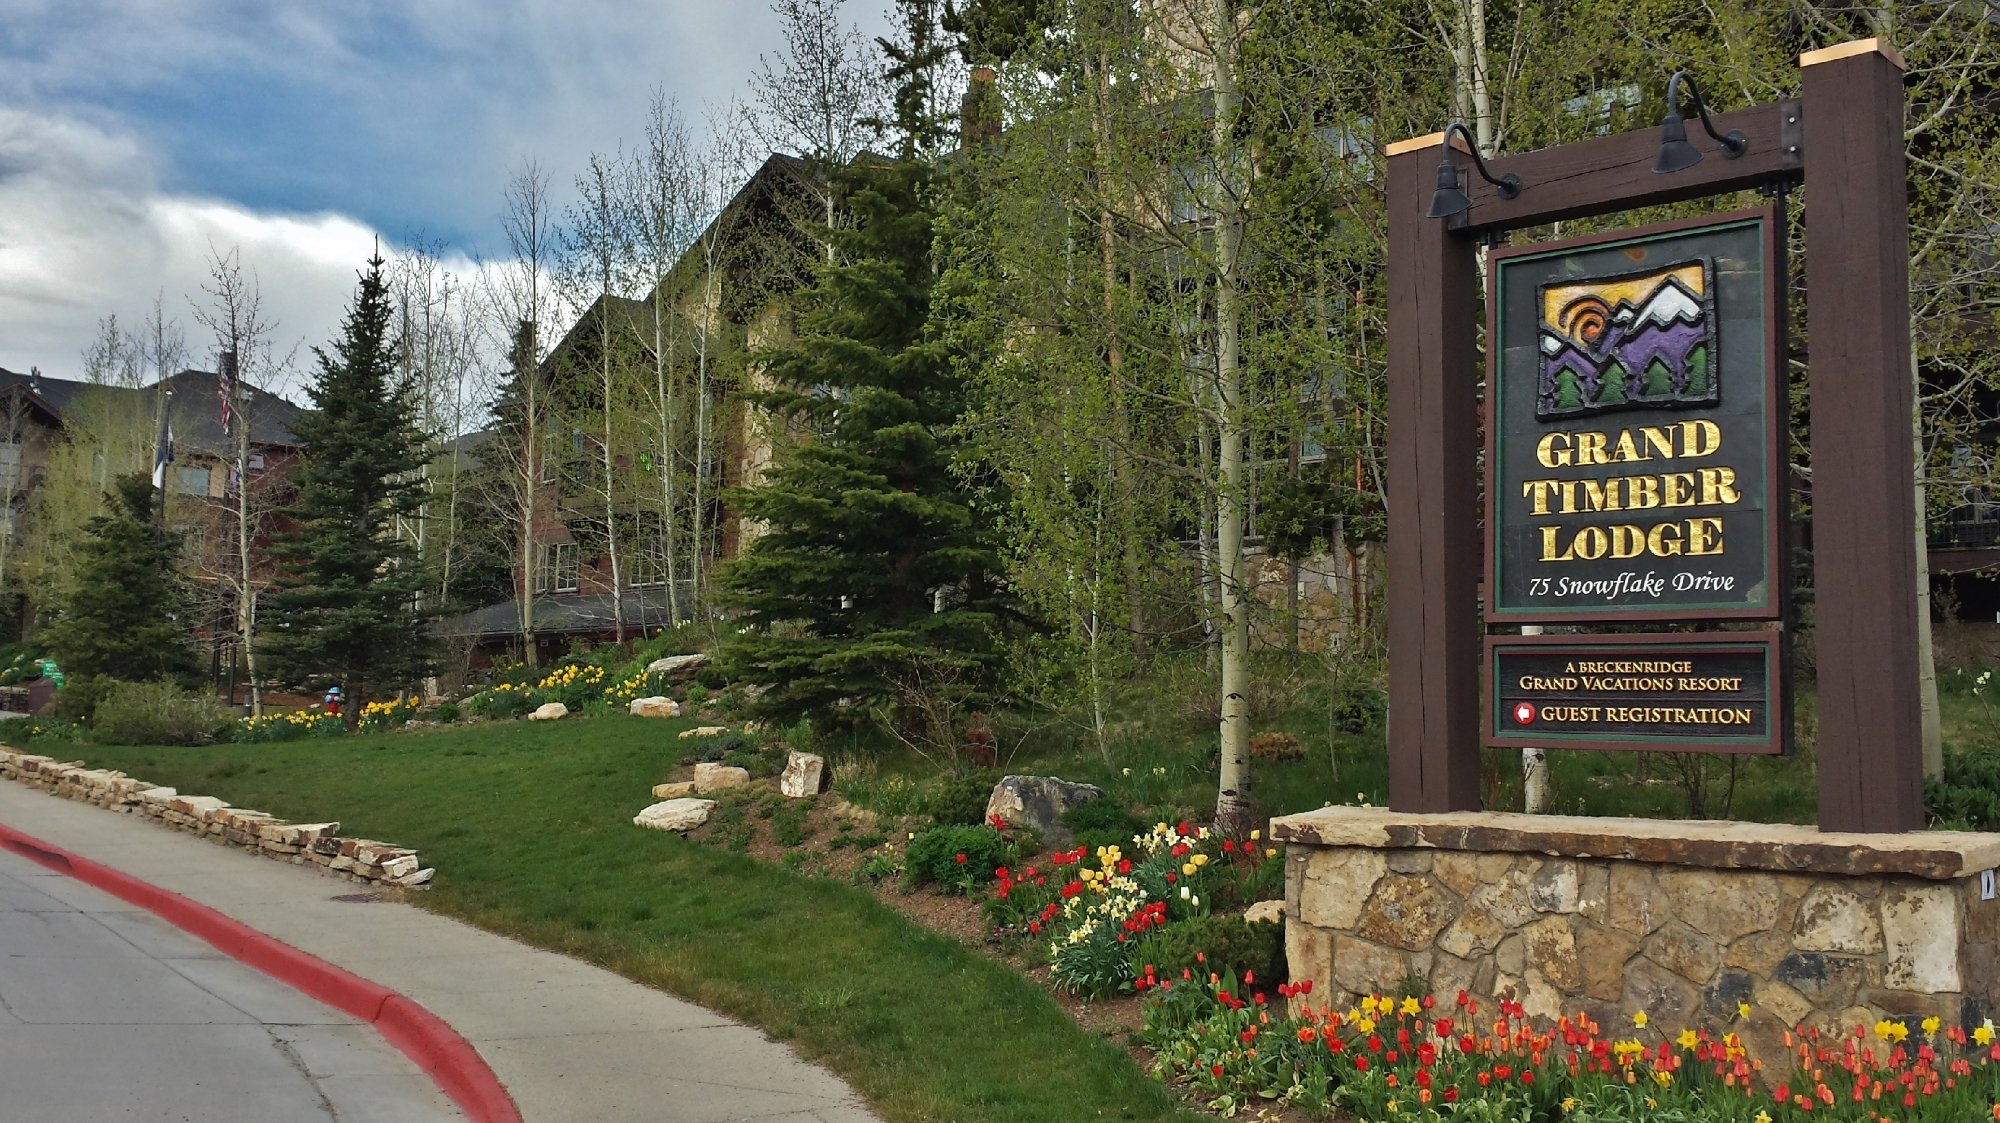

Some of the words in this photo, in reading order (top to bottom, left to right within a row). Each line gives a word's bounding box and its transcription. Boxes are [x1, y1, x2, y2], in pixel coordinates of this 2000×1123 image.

[1536, 419, 1722, 468] GRAND
[1523, 466, 1740, 516] TIMBER
[1538, 517, 1724, 562] LODGE
[1529, 577, 1551, 596] 75
[1555, 570, 1664, 599] Snowflake
[1672, 570, 1735, 591] Drive
[1565, 662, 1575, 673] A
[1579, 661, 1692, 673] BRECKENRIDGE
[1519, 676, 1578, 690] GRAND
[1581, 676, 1673, 691] VACATIONS
[1678, 677, 1742, 691] RESORT
[1541, 707, 1600, 722] GUEST
[1606, 707, 1751, 724] REGISTRATION
